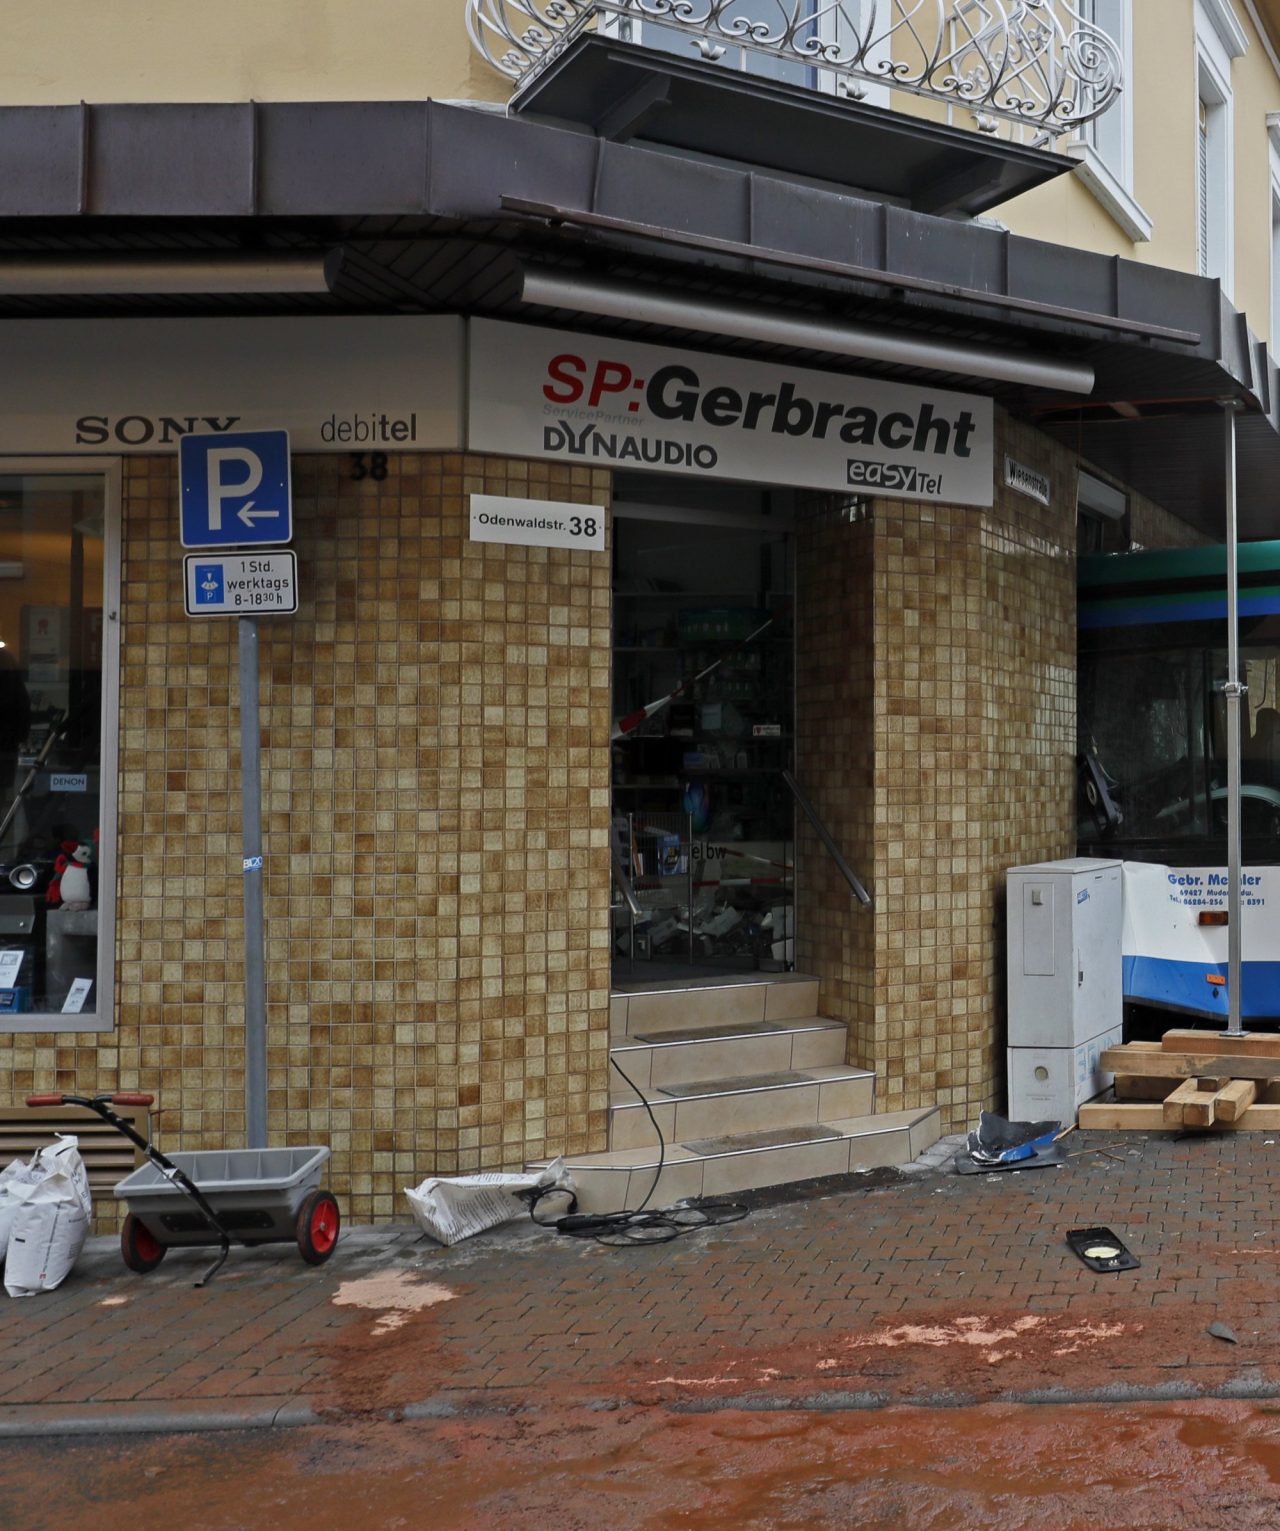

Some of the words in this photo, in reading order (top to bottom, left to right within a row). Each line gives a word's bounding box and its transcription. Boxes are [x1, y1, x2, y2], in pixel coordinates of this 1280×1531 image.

[320, 413, 417, 441] debitel
[544, 420, 718, 469] DYNAUDIO
[351, 451, 388, 481] 38
[207, 447, 263, 530] P
[478, 513, 566, 531] Odenwaldstr.
[569, 516, 597, 537] 38
[249, 560, 274, 573] Std.
[227, 577, 289, 591] werktags
[52, 777, 85, 786] DENON
[1168, 874, 1204, 886] Gebr.
[1208, 874, 1262, 886] Meler
